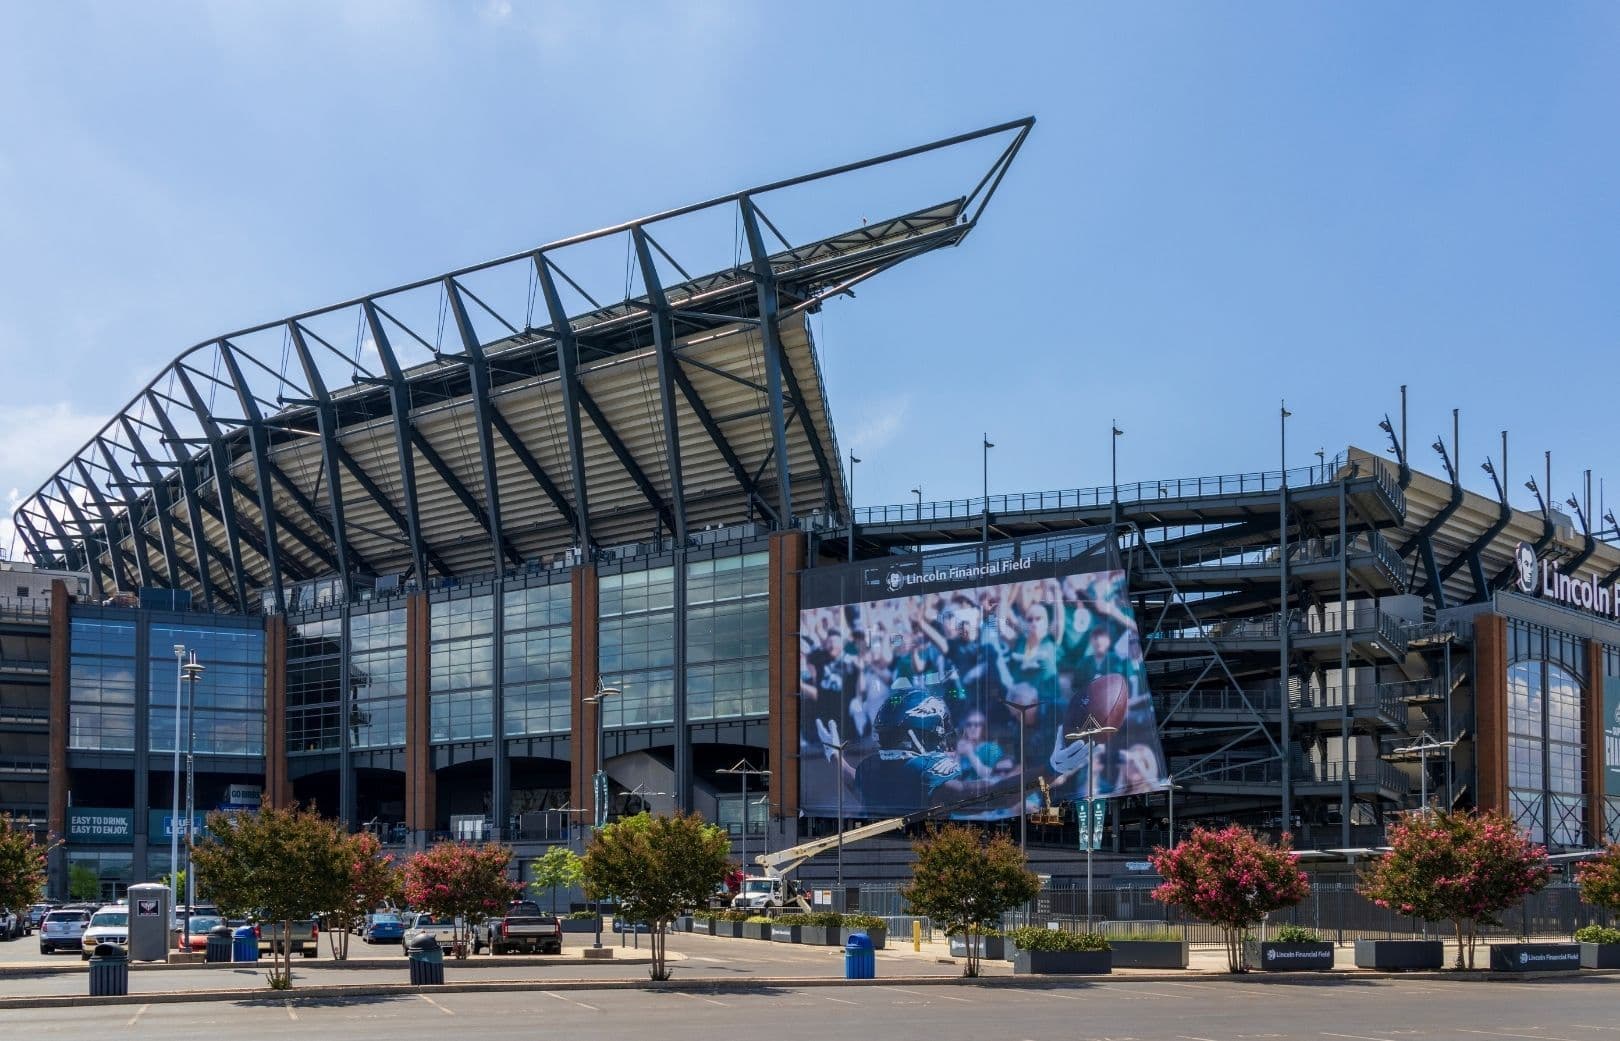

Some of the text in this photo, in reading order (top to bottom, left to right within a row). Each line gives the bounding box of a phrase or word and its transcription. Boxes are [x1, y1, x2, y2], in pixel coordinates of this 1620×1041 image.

[906, 557, 1032, 585] Lincoln Financial Field
[1542, 558, 1611, 615] Lincoln
[231, 790, 241, 798] GO
[71, 816, 128, 826] EASY TO DRINK,
[71, 825, 128, 835] EASY TO ENJOY.
[1318, 950, 1331, 958] Field
